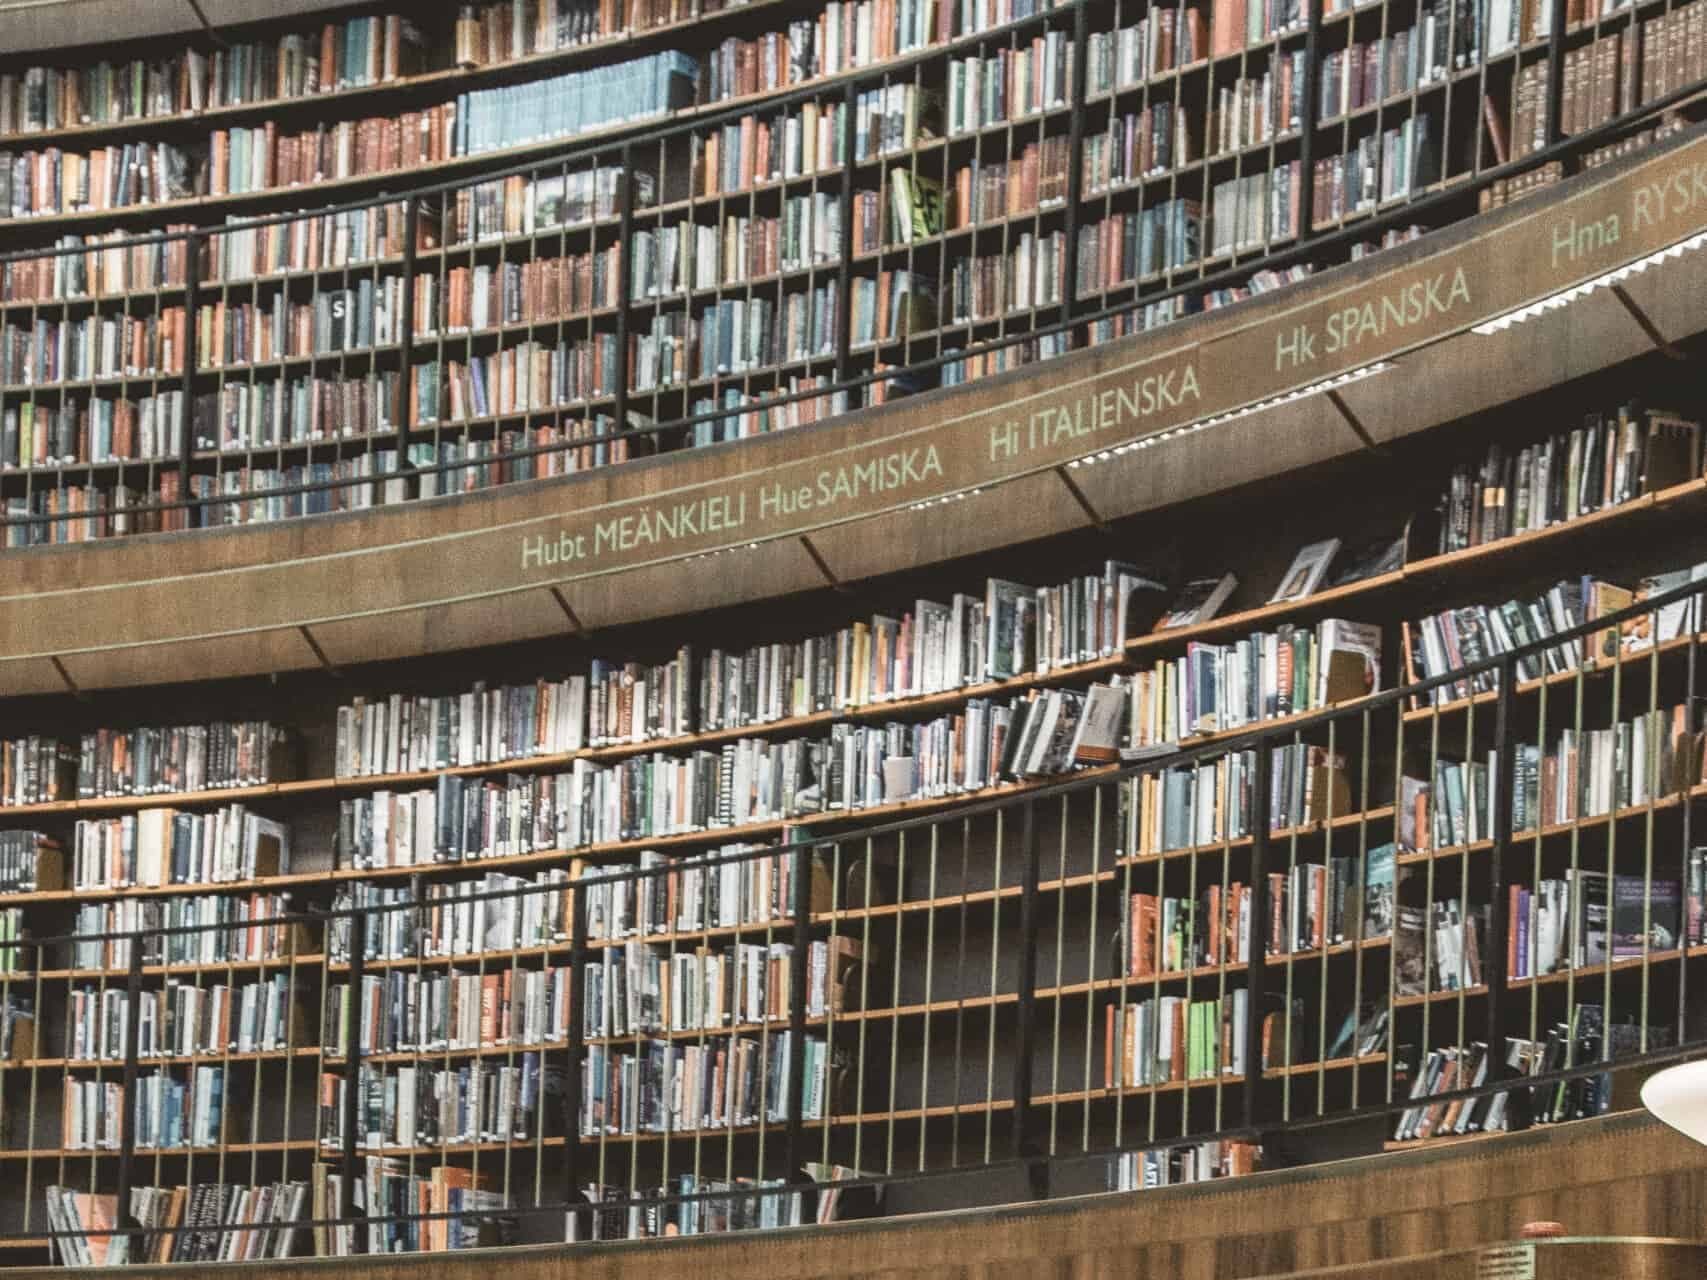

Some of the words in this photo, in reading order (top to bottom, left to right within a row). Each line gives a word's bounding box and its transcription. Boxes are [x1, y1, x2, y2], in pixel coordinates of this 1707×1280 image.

[1551, 213, 1620, 267] Hma
[1632, 162, 1707, 230] RYSK
[1274, 326, 1317, 371] Hk
[1326, 266, 1470, 352] SPANSKA
[990, 421, 1020, 461] Hi
[1029, 364, 1200, 449] ITALIENSKA
[594, 495, 746, 555] MEÄNKIELI
[759, 482, 813, 519] Hue
[817, 444, 943, 505] SAMISKA
